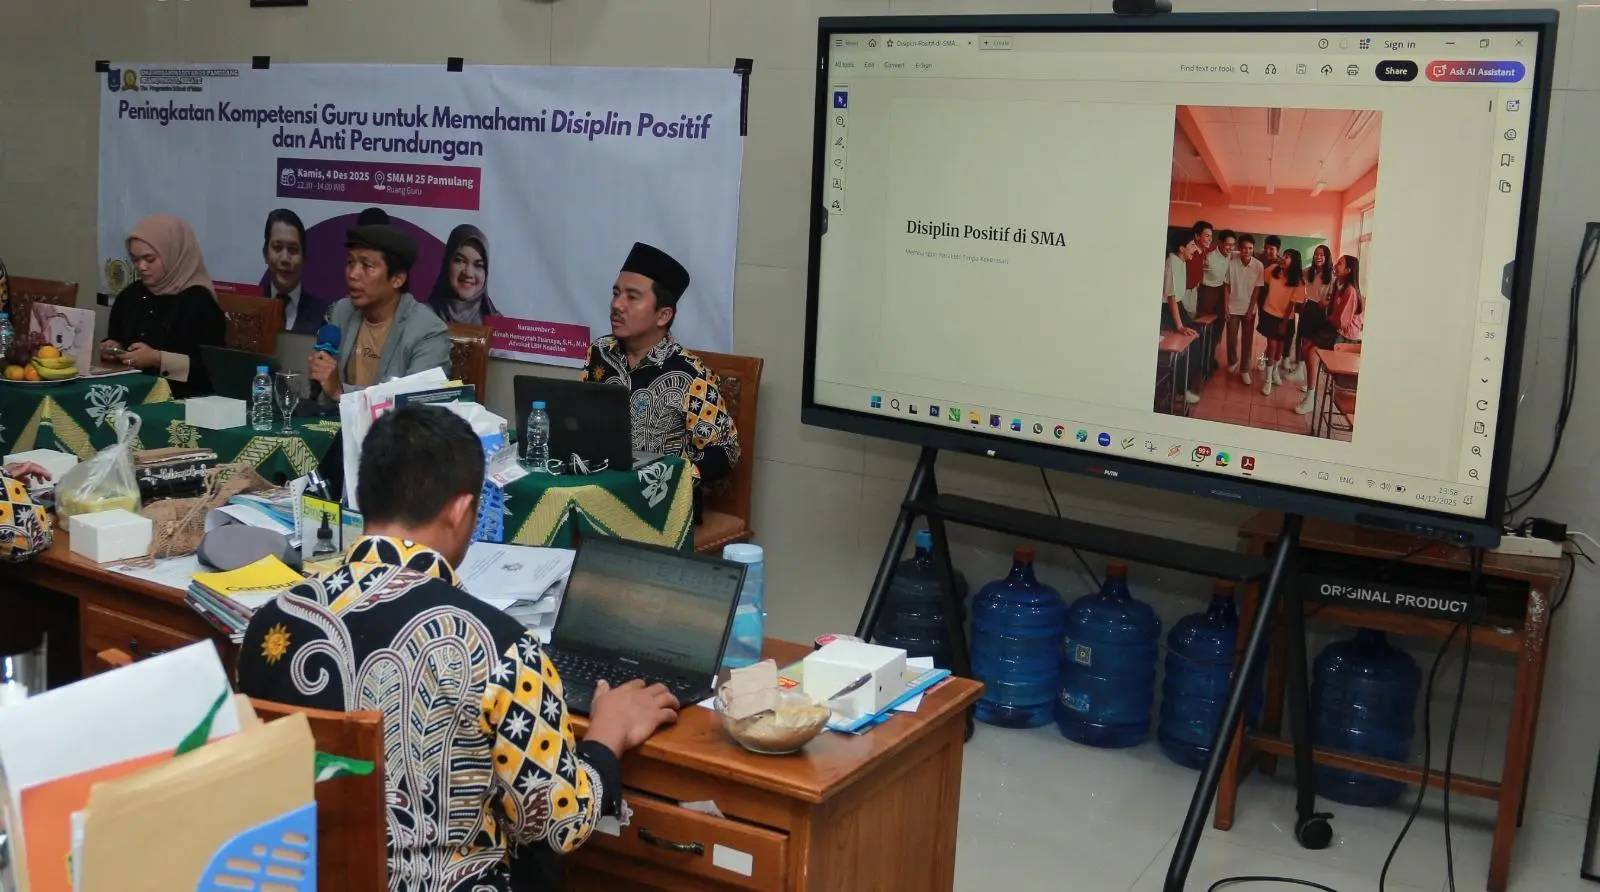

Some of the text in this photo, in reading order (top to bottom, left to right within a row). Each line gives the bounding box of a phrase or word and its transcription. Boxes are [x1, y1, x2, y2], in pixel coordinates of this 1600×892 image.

[1384, 40, 1416, 51] Sign in
[1180, 64, 1195, 72] Find
[1385, 66, 1408, 75] Share
[1450, 68, 1515, 77] Ask AI Assistant
[118, 100, 713, 141] Peningkatan Kompetensi Guru untuk Memahami Disiplin Positif
[272, 126, 483, 161] dan Anti Perundungan
[297, 168, 370, 181] Kamis, 4 Des 2025
[387, 173, 474, 189] SMA M 25 Pamulang
[387, 185, 422, 195] Ruang Guru
[906, 220, 1066, 247] Disiplin Positif di SMA
[517, 324, 550, 334] Narasumber
[1484, 331, 1495, 339] 35
[542, 343, 566, 352] Keadilan
[1339, 476, 1354, 485] ENG
[1438, 487, 1459, 496] 13:58
[1415, 493, 1457, 507] 04/12/2025
[1320, 584, 1468, 613] ORIGINAL PRODUCT
